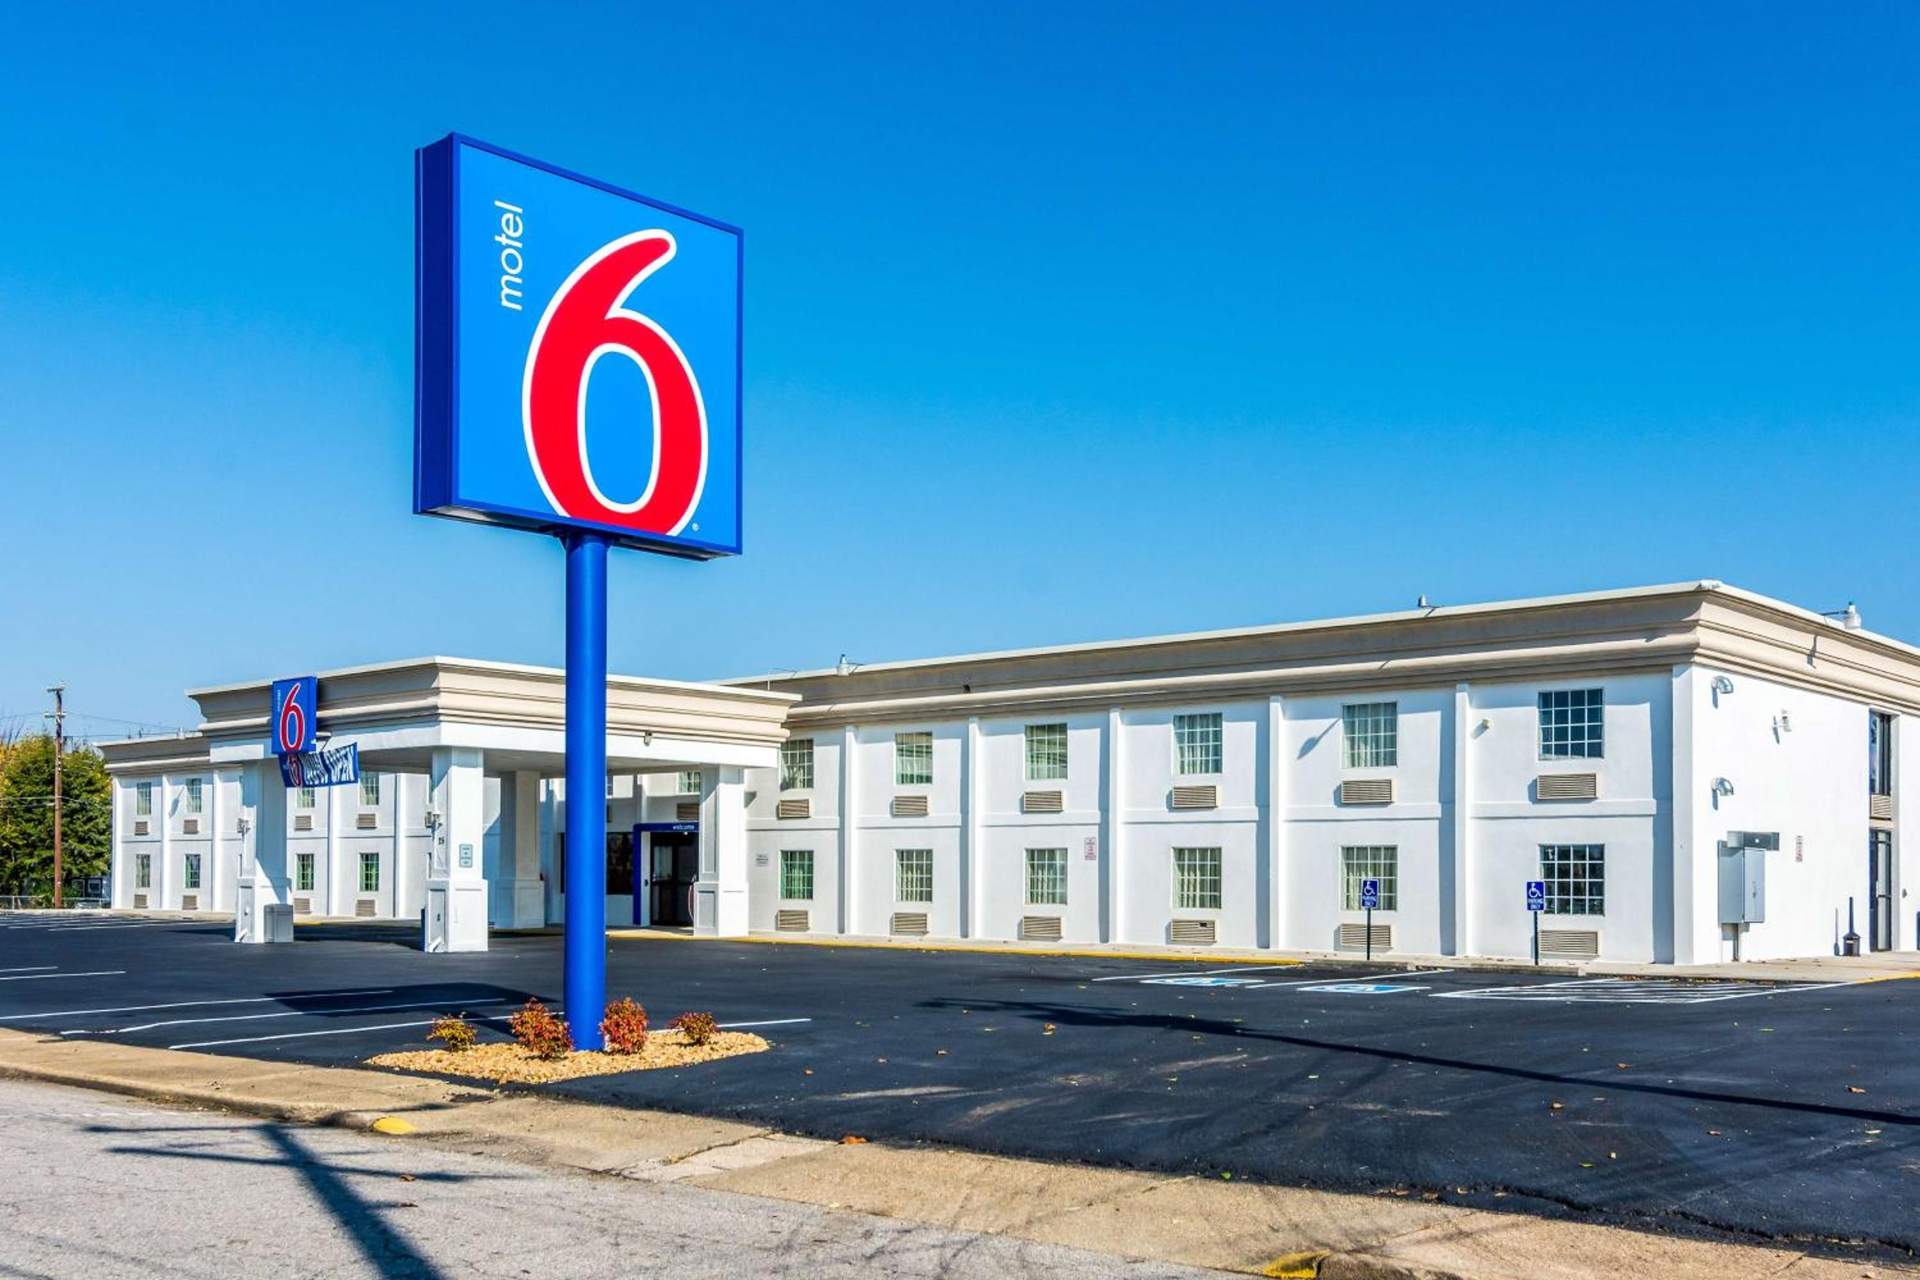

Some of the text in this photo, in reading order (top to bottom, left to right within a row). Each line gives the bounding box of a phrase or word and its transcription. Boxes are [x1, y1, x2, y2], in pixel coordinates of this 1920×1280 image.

[494, 200, 708, 536] motel 6
[280, 683, 305, 751] 6
[324, 745, 355, 783] OPEN
